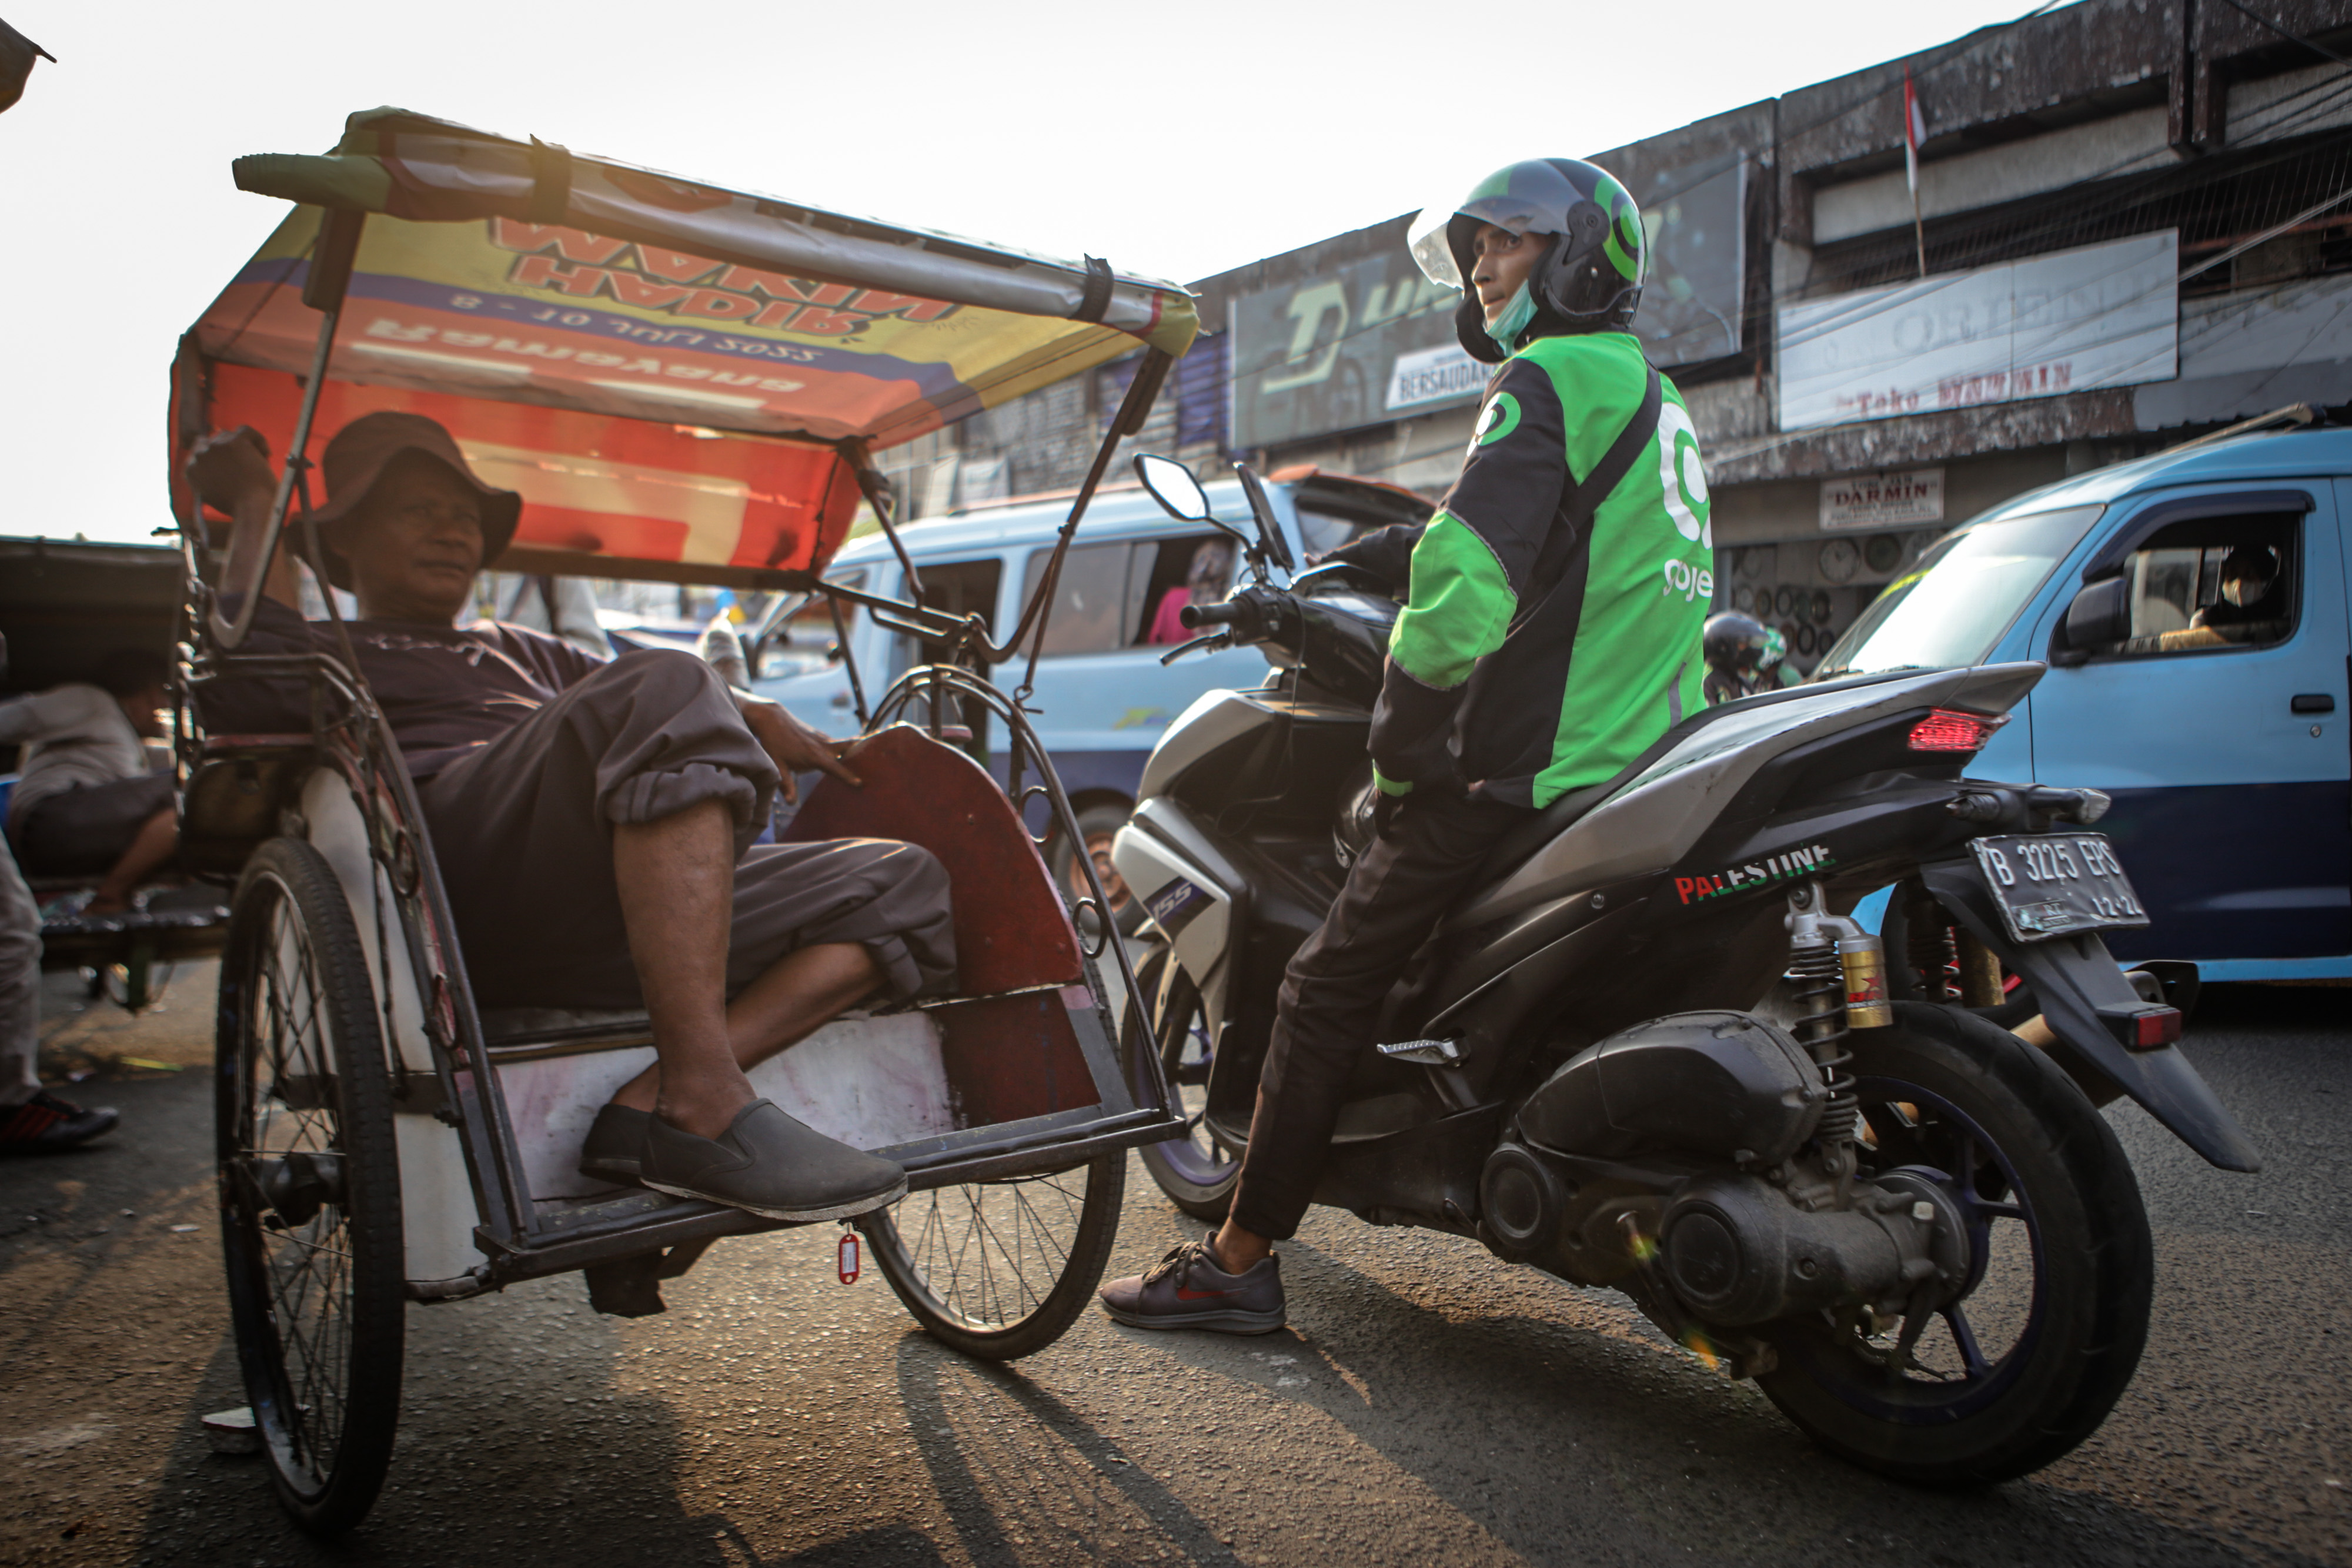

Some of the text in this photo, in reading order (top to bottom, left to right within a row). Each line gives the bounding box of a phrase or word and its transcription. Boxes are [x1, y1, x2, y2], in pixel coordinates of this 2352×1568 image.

[1673, 842, 1837, 905] PALESTINE
[1989, 840, 2121, 886] B 3225 EPS
[1152, 881, 1192, 922] 155
